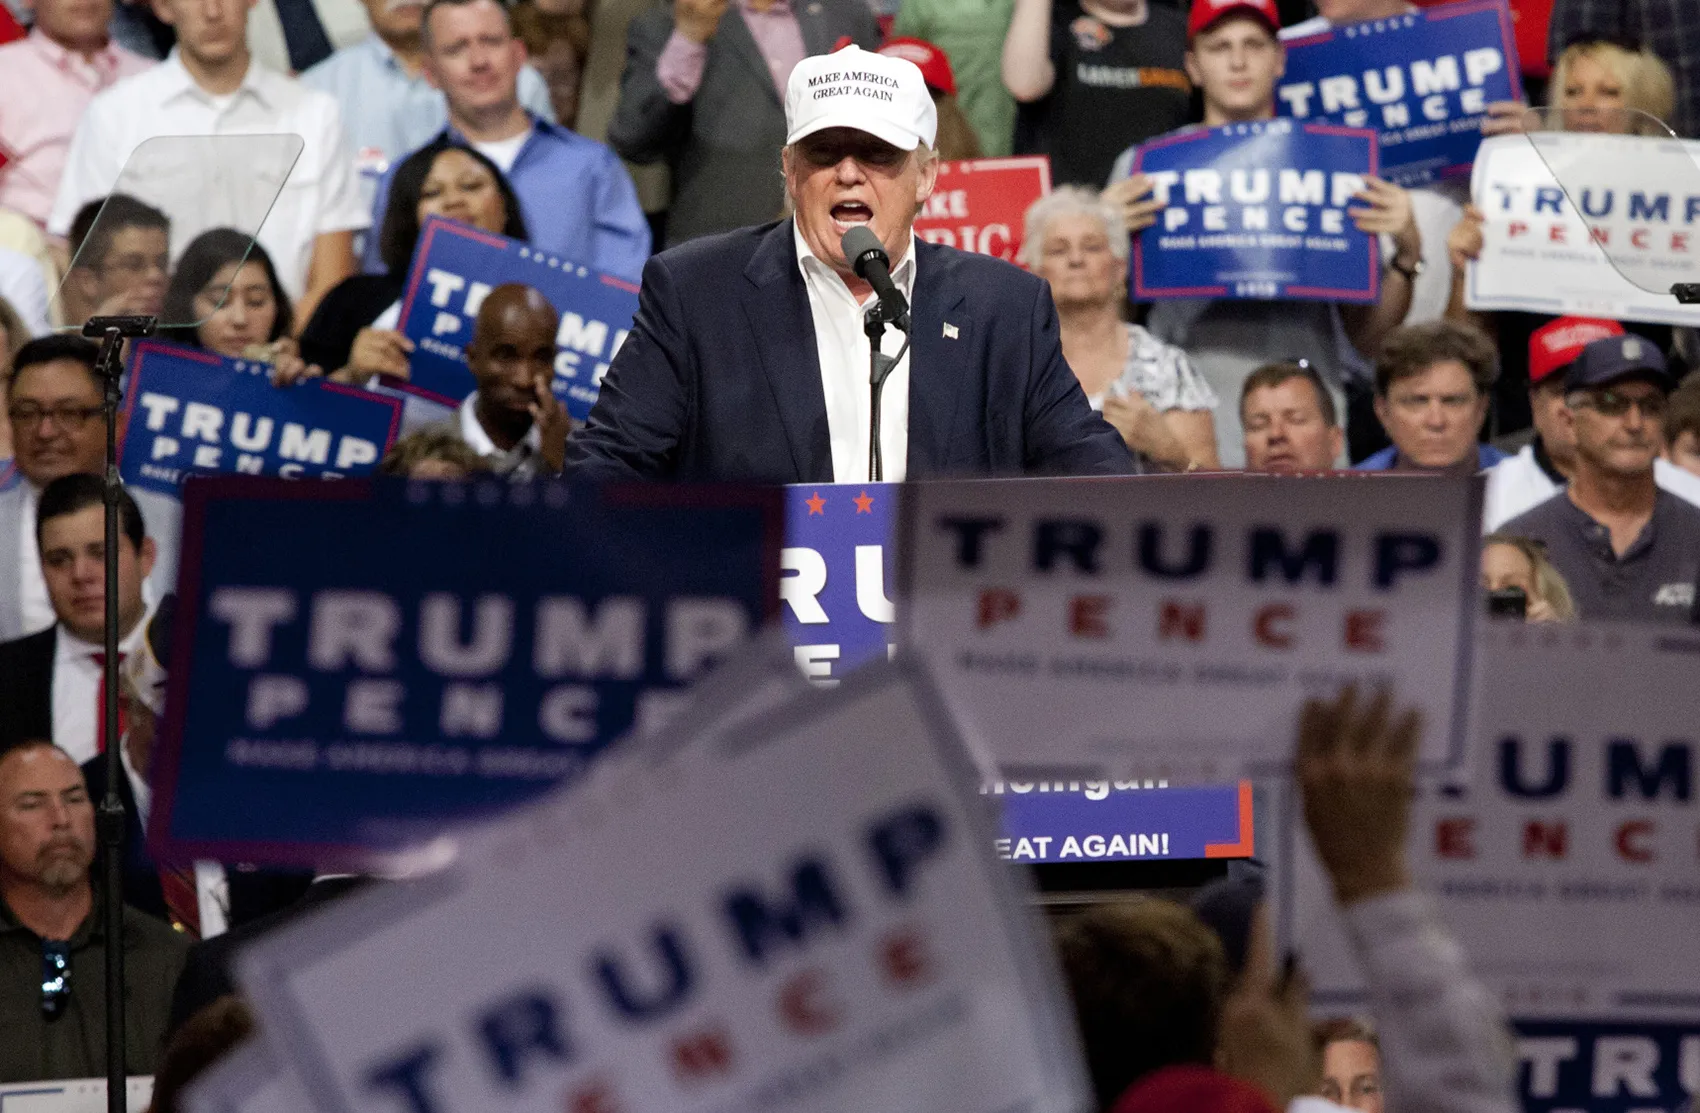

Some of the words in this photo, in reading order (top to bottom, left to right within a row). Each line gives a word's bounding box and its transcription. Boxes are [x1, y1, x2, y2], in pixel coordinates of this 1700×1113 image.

[807, 71, 841, 88] MAKE
[842, 71, 900, 89] AMERICA
[813, 85, 852, 100] GREAT
[853, 86, 893, 103] AGAIN
[1279, 47, 1502, 117] TRUMP
[1145, 167, 1366, 207] TRUMP
[1163, 206, 1344, 233] PENCE
[1508, 221, 1689, 252] PENCE
[141, 392, 378, 468] TRUMP
[936, 516, 1443, 591] TRUMP
[210, 588, 748, 679] TRUMP
[974, 590, 1386, 653] PENCE
[1059, 833, 1169, 858] AGAIN!
